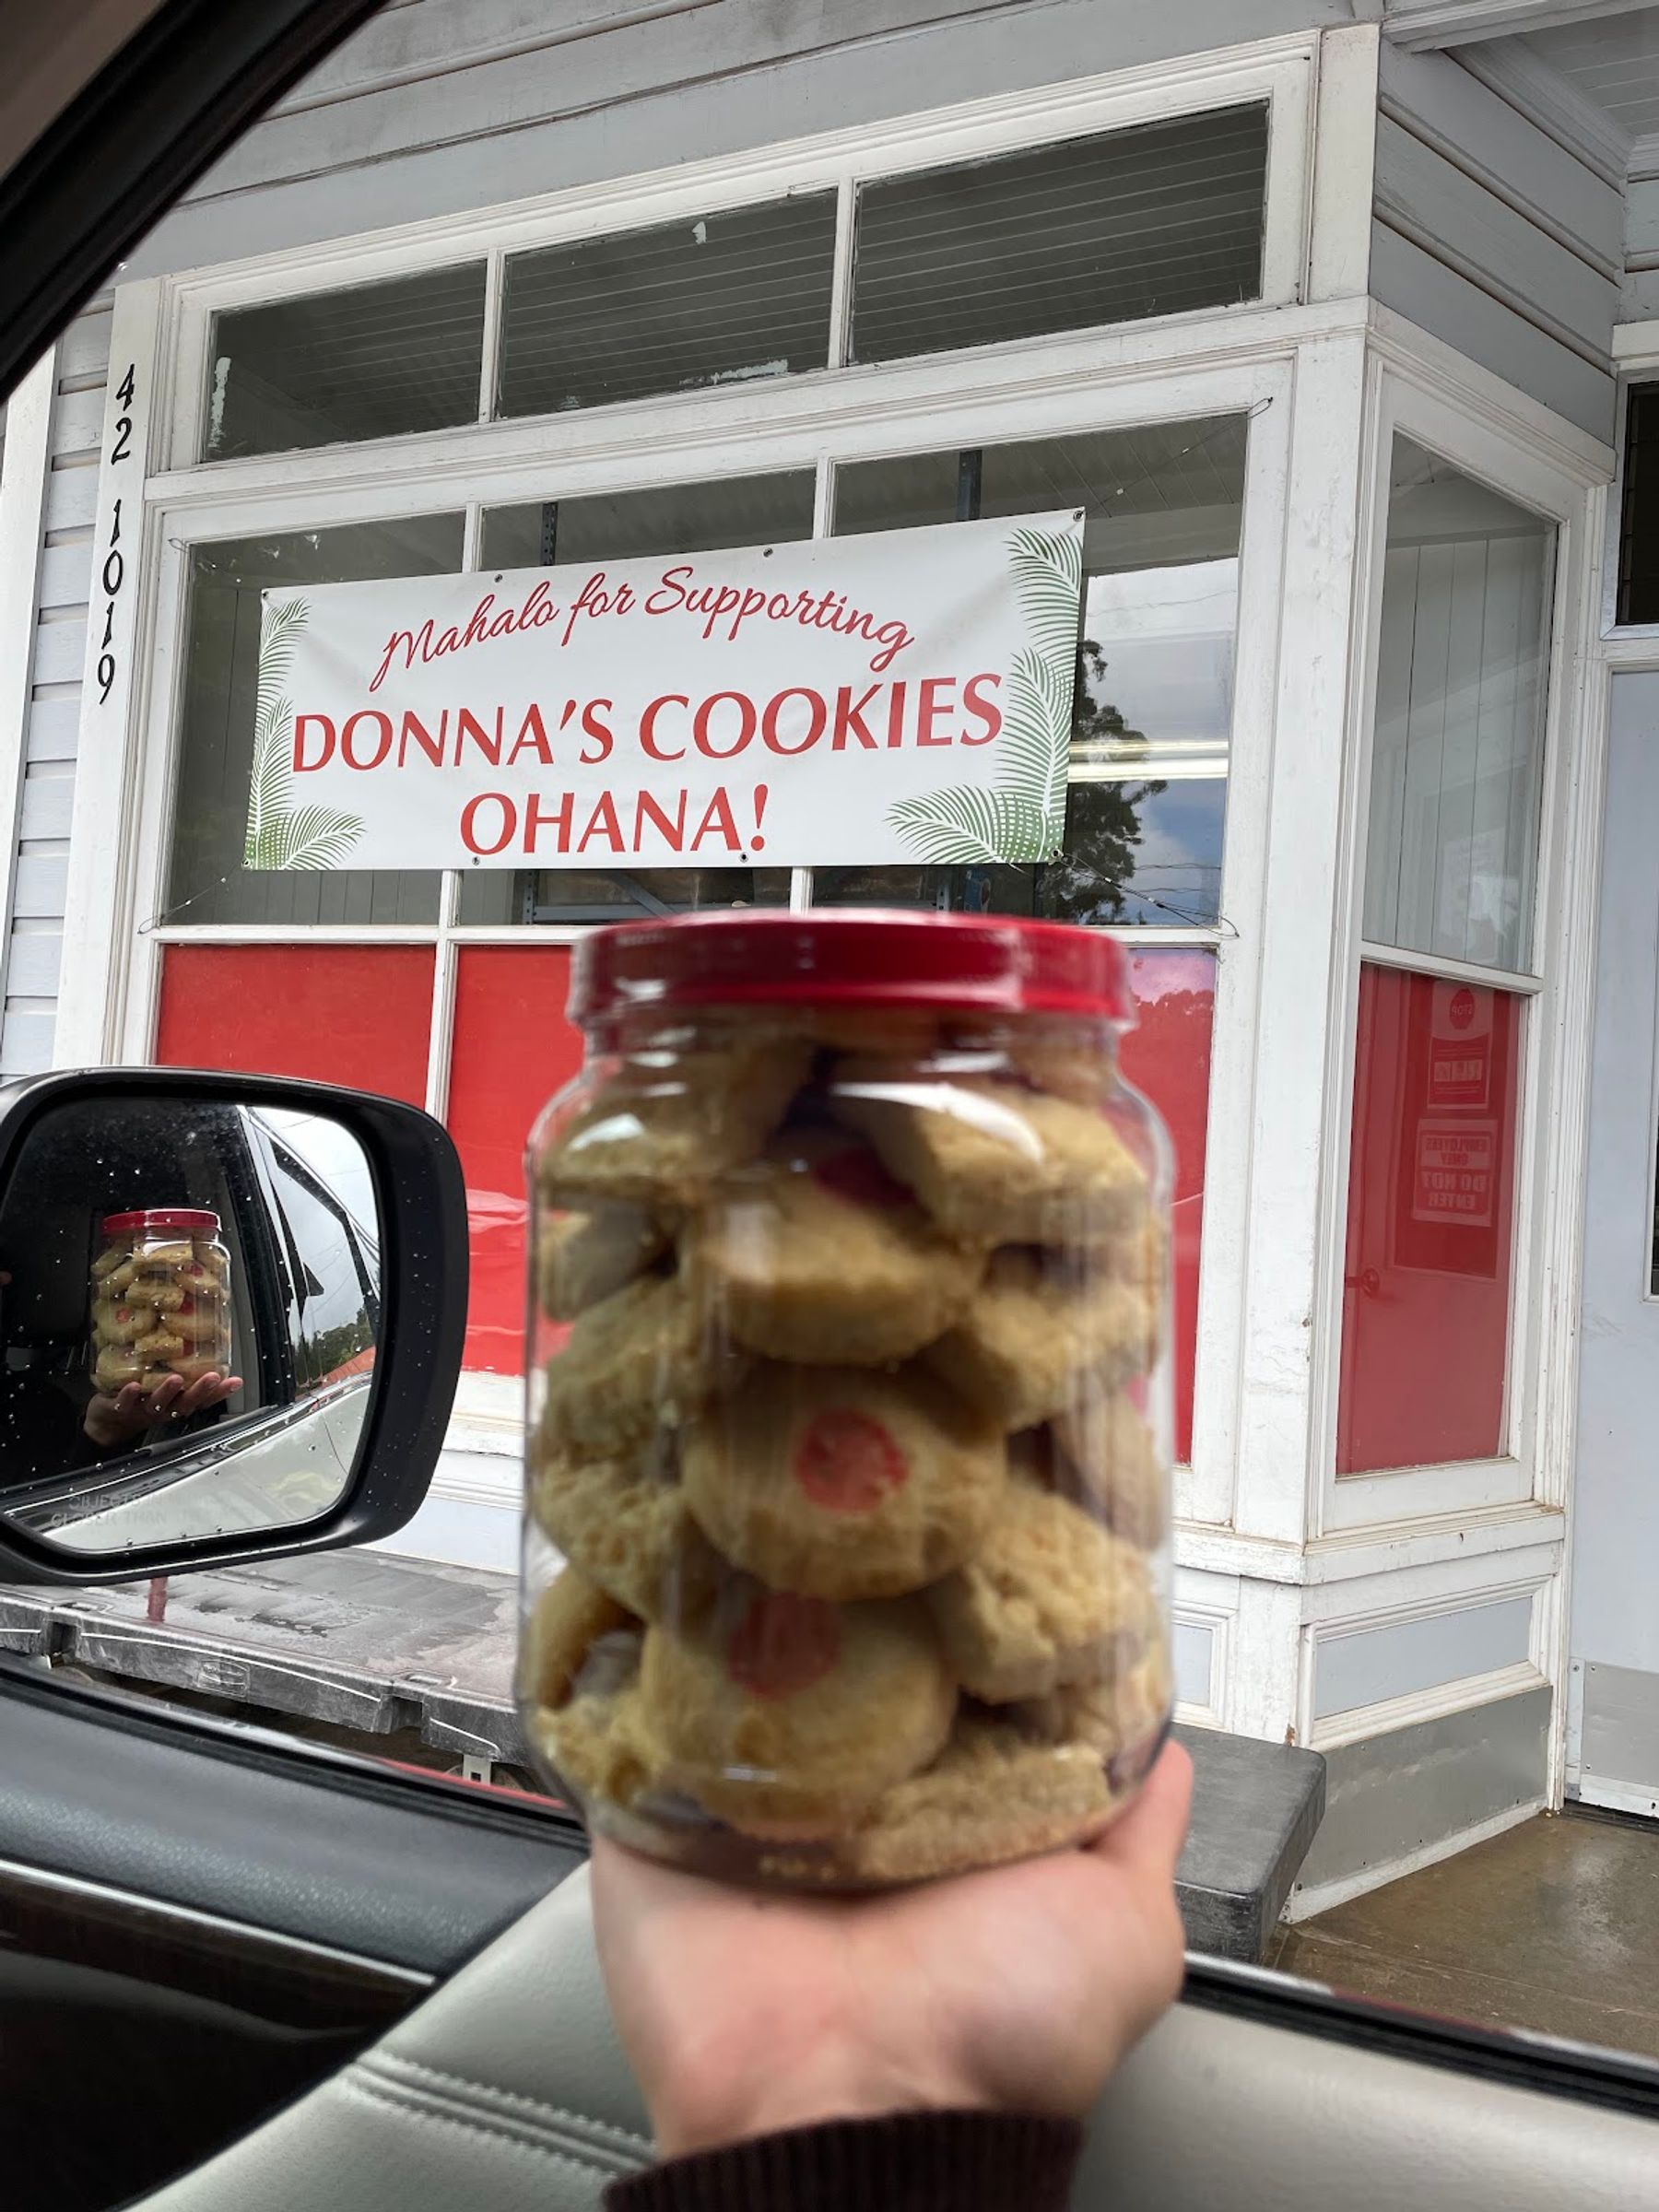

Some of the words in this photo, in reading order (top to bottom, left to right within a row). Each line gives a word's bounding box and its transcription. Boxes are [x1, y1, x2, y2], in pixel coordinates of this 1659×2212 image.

[111, 363, 135, 465] 42
[98, 499, 123, 706] 1019
[370, 580, 559, 692] Mahalo
[561, 573, 636, 646] for
[644, 566, 915, 674] Supporting
[292, 698, 615, 773] DONNA'S
[639, 674, 1002, 764] COOKIES
[460, 783, 769, 856] OHANA!
